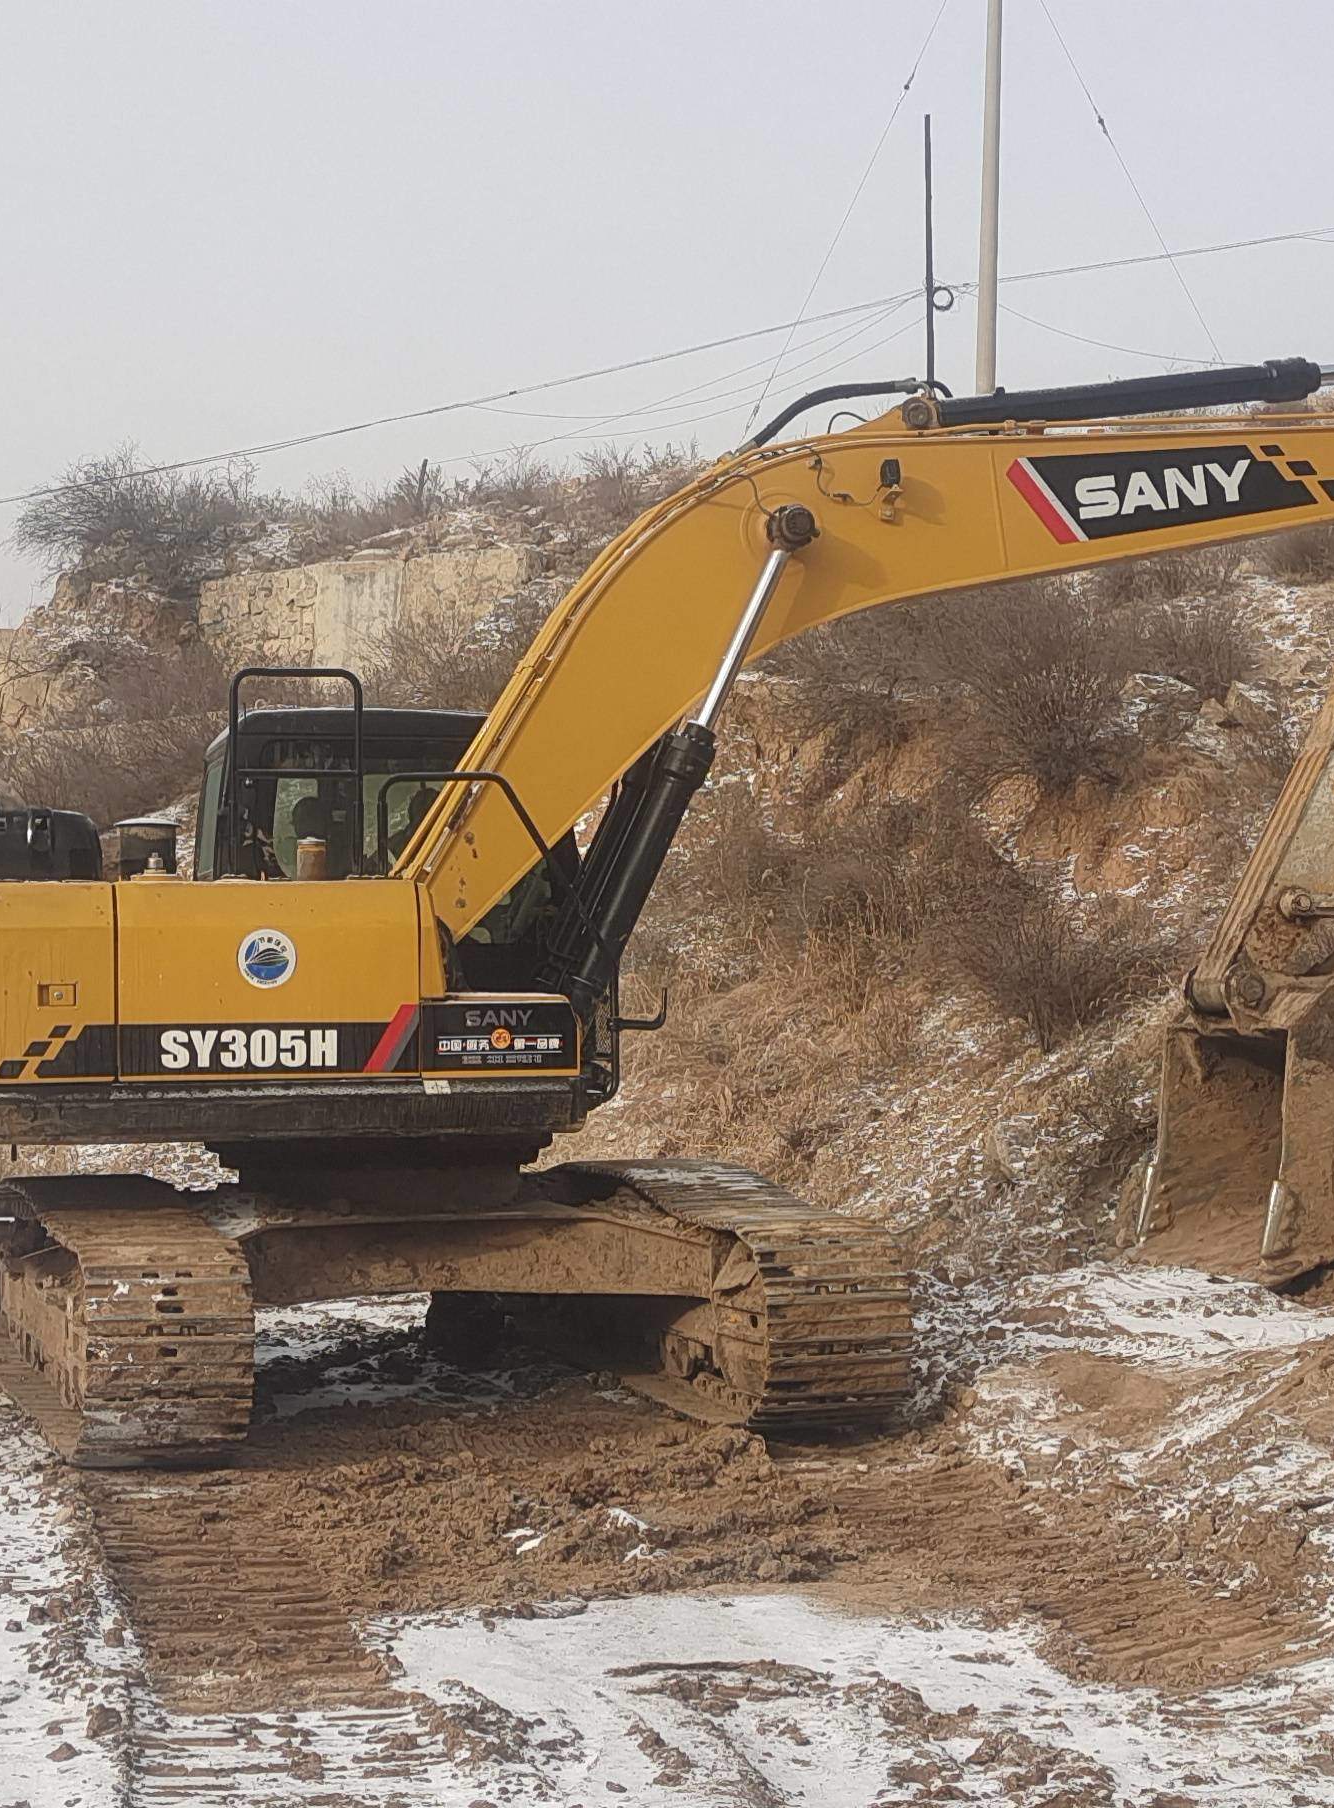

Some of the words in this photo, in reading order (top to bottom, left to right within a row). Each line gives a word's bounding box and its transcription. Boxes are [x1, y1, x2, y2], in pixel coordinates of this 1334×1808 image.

[1075, 459, 1251, 520] SANY
[465, 1009, 533, 1027] SANY
[160, 1029, 338, 1069] SY305H
